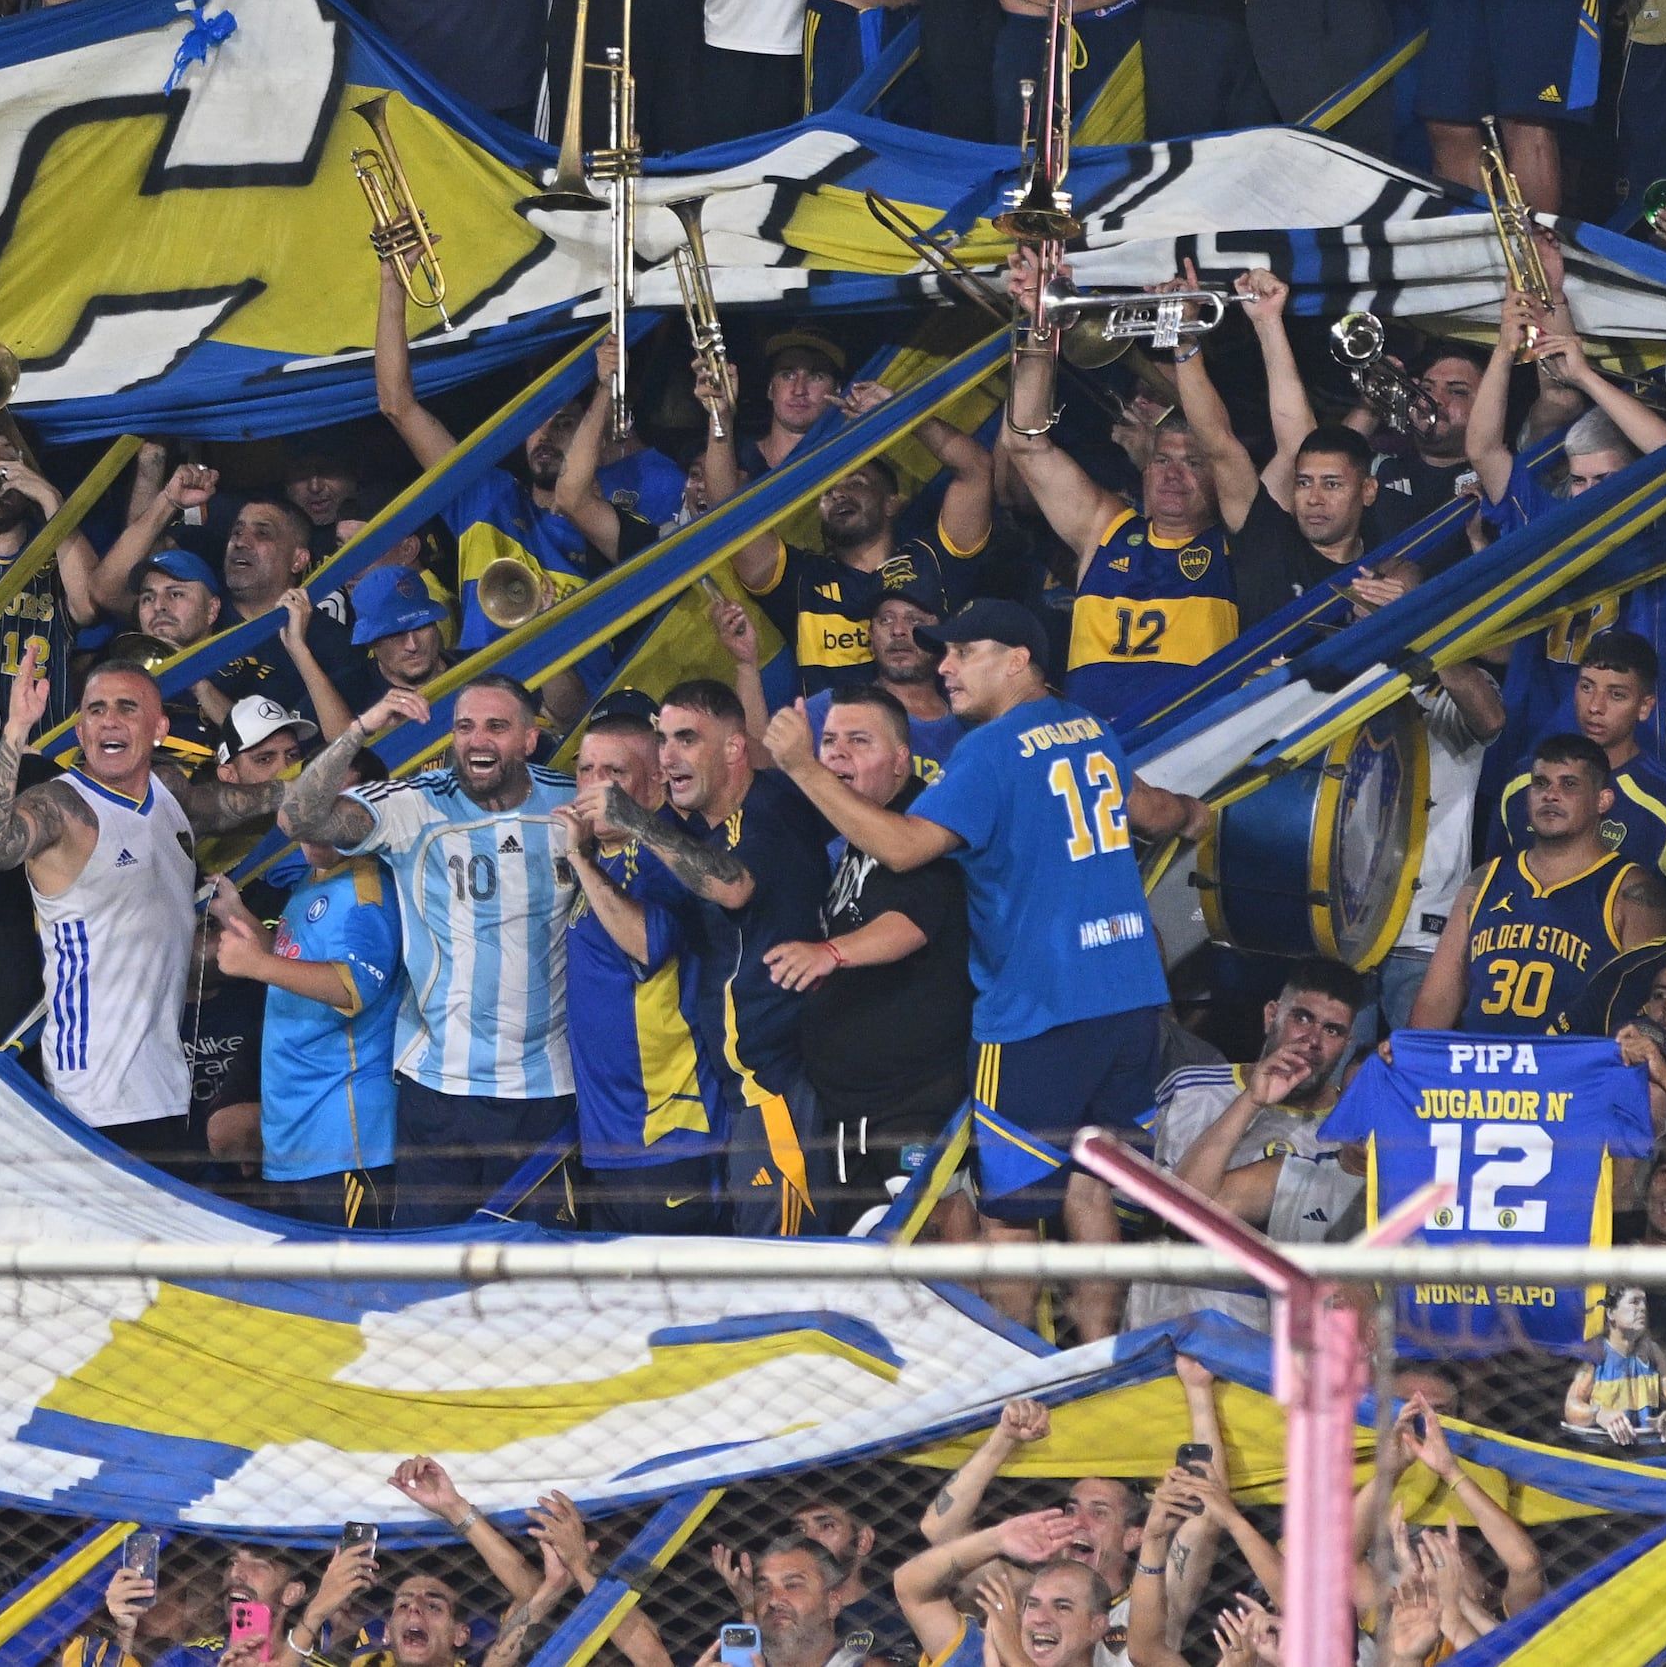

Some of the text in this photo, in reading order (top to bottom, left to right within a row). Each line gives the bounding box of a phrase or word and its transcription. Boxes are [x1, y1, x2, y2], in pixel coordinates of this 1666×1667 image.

[1109, 607, 1166, 658] 12
[1047, 750, 1132, 862] 12
[447, 854, 498, 902] 10
[1472, 923, 1592, 974] GOLDEN STATE
[1480, 958, 1555, 1019] 30
[184, 1036, 244, 1057] Nike
[1448, 1043, 1539, 1075] PIPA
[1414, 1089, 1539, 1121] JUGADOR
[1424, 1122, 1555, 1232] 12
[1415, 1284, 1556, 1307] NUNCA SAPO
